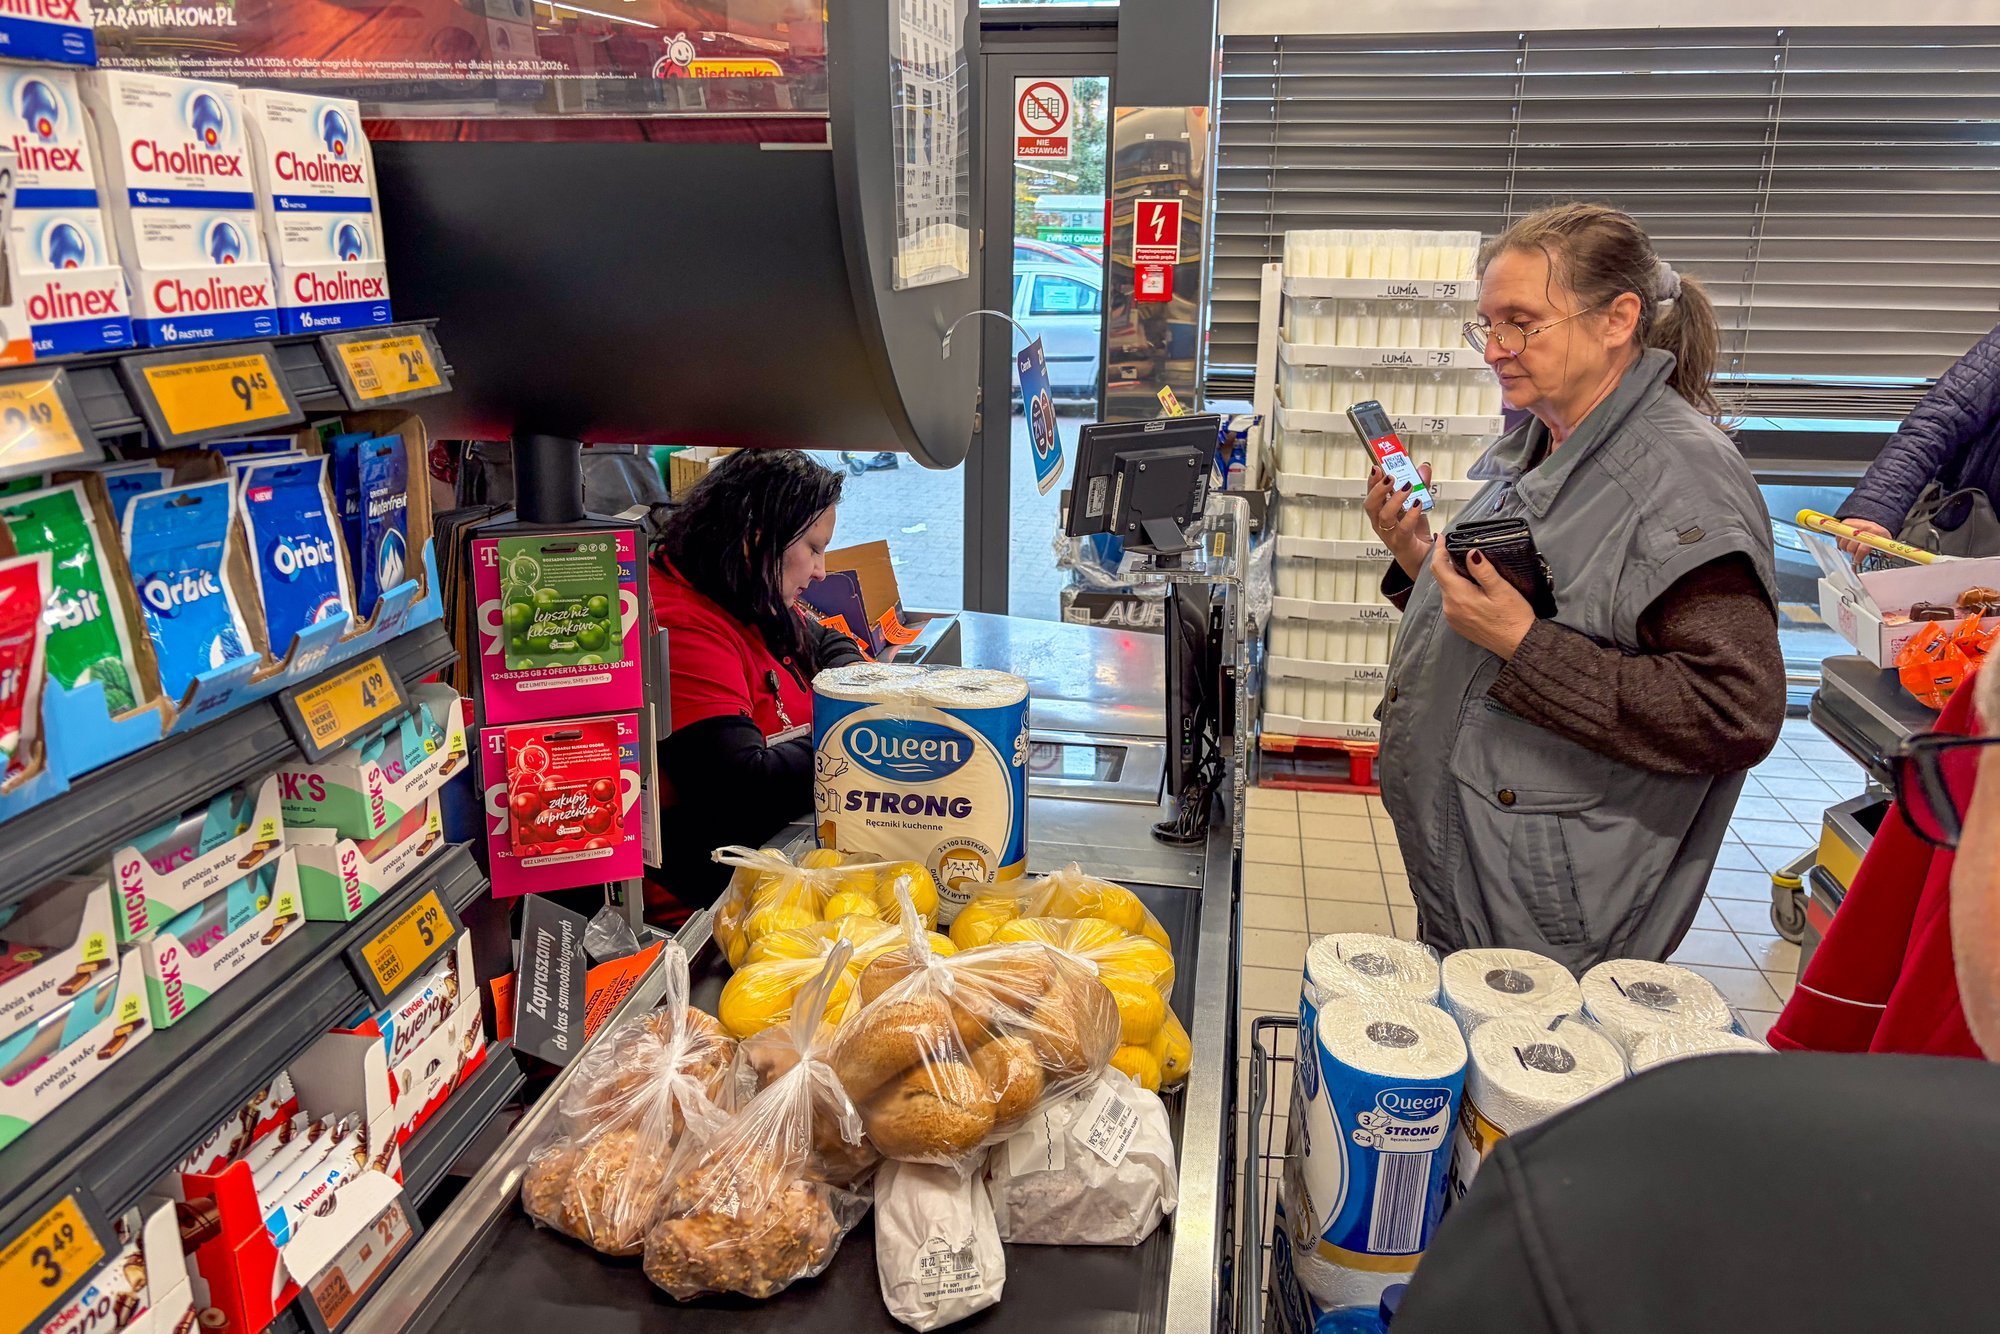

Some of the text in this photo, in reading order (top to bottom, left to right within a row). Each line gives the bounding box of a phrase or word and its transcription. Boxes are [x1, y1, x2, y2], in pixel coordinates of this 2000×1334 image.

[233, 57, 245, 68] do
[351, 59, 363, 69] do
[506, 61, 517, 70] do
[518, 61, 562, 71] 28.11.2026
[1019, 144, 1066, 155] ZASTAWIAĆ!
[1036, 138, 1050, 147] NIE
[131, 139, 243, 177] Cholinex
[275, 150, 364, 185] Cholinex
[1075, 234, 1104, 243] OPAKO
[153, 277, 270, 315] Cholinex
[294, 270, 385, 304] Cholinex
[299, 311, 313, 327] 16
[160, 323, 178, 342] 16
[399, 352, 419, 383] 2
[231, 375, 252, 411] 9
[253, 489, 273, 502] NEW
[274, 536, 334, 575] Orbit
[145, 569, 220, 612] Orbit
[534, 605, 590, 624] lepsze niż
[526, 621, 596, 641] kieszonkowe
[530, 668, 542, 677] GB
[548, 665, 578, 676] OFERTĄ
[577, 664, 587, 673] 35
[598, 662, 609, 671] CO
[610, 661, 620, 670] 30
[620, 660, 634, 669] DNI
[361, 672, 384, 709] 4 99
[311, 710, 333, 726] NISKIE
[316, 719, 337, 736] CENY
[850, 726, 961, 766] Queen
[549, 791, 590, 810] zakupy
[844, 789, 972, 819] STRONG
[547, 806, 599, 828] prezencie
[865, 818, 943, 832] Ręczniki kuchenne
[946, 839, 959, 848] 100
[960, 839, 990, 856] LISTKÓW
[181, 851, 238, 890] protein wafer
[202, 873, 220, 889] mix
[929, 867, 947, 895] DUŻYCH
[416, 906, 439, 947] 5 99
[212, 929, 261, 971] protein wafer
[231, 952, 246, 968] mix
[377, 955, 398, 974] NISKIE
[382, 963, 401, 982] CENY
[526, 926, 556, 1021] Zapraszamy
[27, 976, 58, 999] wafer
[552, 918, 576, 1051] do kas samoobsługowych
[14, 1003, 36, 1021] mix
[33, 1043, 97, 1096] protein wafer
[58, 1072, 78, 1090] mix
[1382, 1092, 1445, 1113] Queen
[1362, 1115, 1371, 1126] 3
[1383, 1124, 1440, 1137] STRONG
[31, 1245, 62, 1288] 3
[52, 1223, 74, 1252] 49
